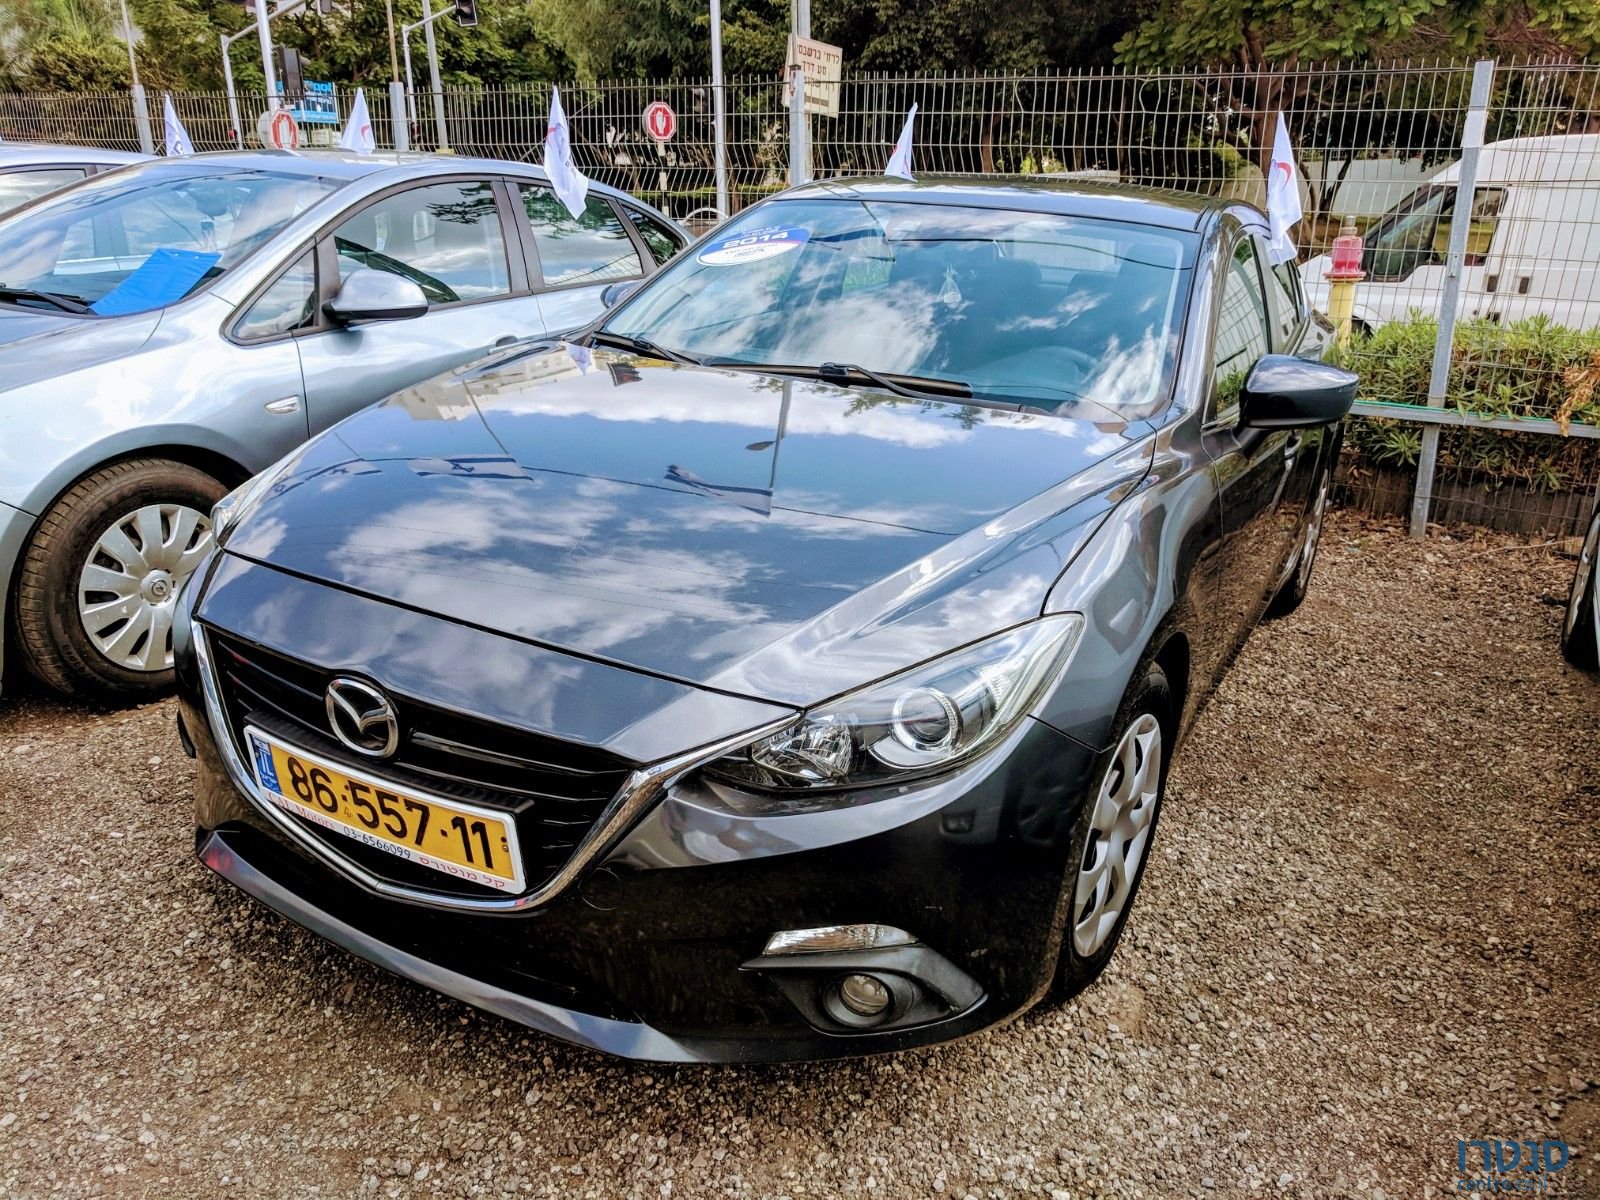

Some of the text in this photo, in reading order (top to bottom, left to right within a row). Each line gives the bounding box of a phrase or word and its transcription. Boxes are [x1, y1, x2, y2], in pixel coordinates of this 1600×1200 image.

[722, 231, 789, 249] 2014
[343, 826, 411, 859] 03-6566099
[419, 857, 505, 889] קל מוטורס
